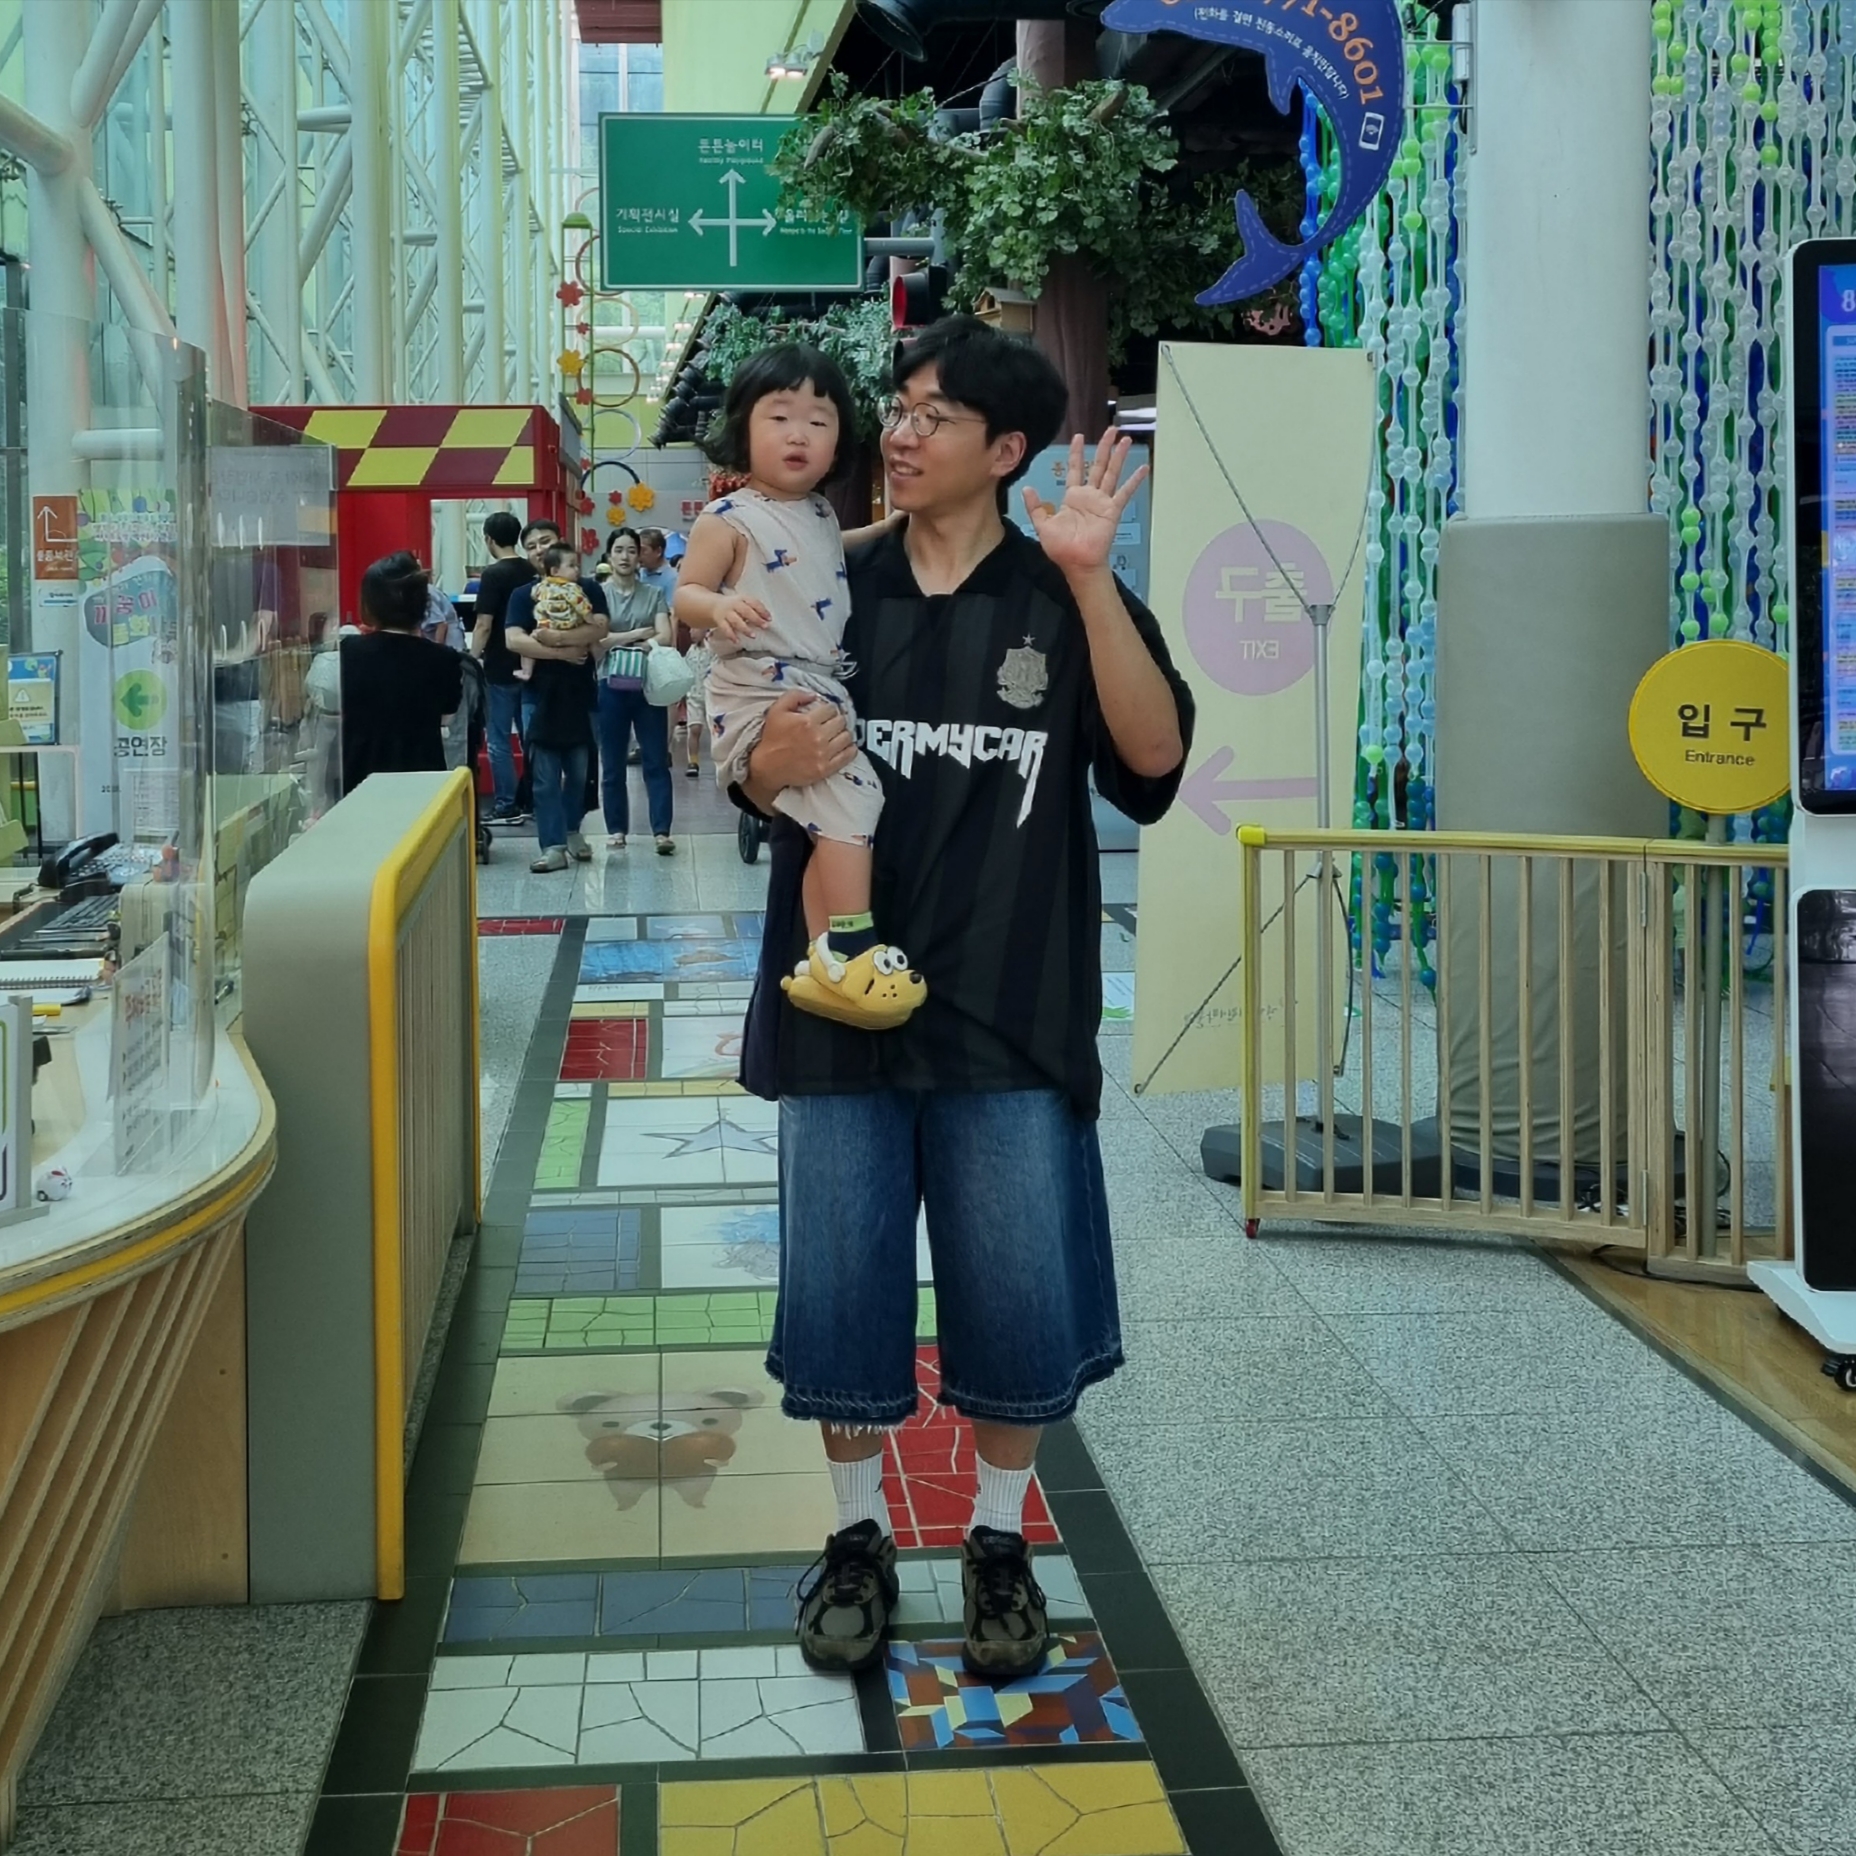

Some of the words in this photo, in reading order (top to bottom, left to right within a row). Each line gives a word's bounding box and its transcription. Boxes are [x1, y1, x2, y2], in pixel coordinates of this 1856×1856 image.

[697, 138, 763, 154] 튼튼놀이터
[616, 207, 679, 223] 기획전시실
[113, 736, 168, 758] 공연장
[1685, 749, 1756, 766] Entrance
